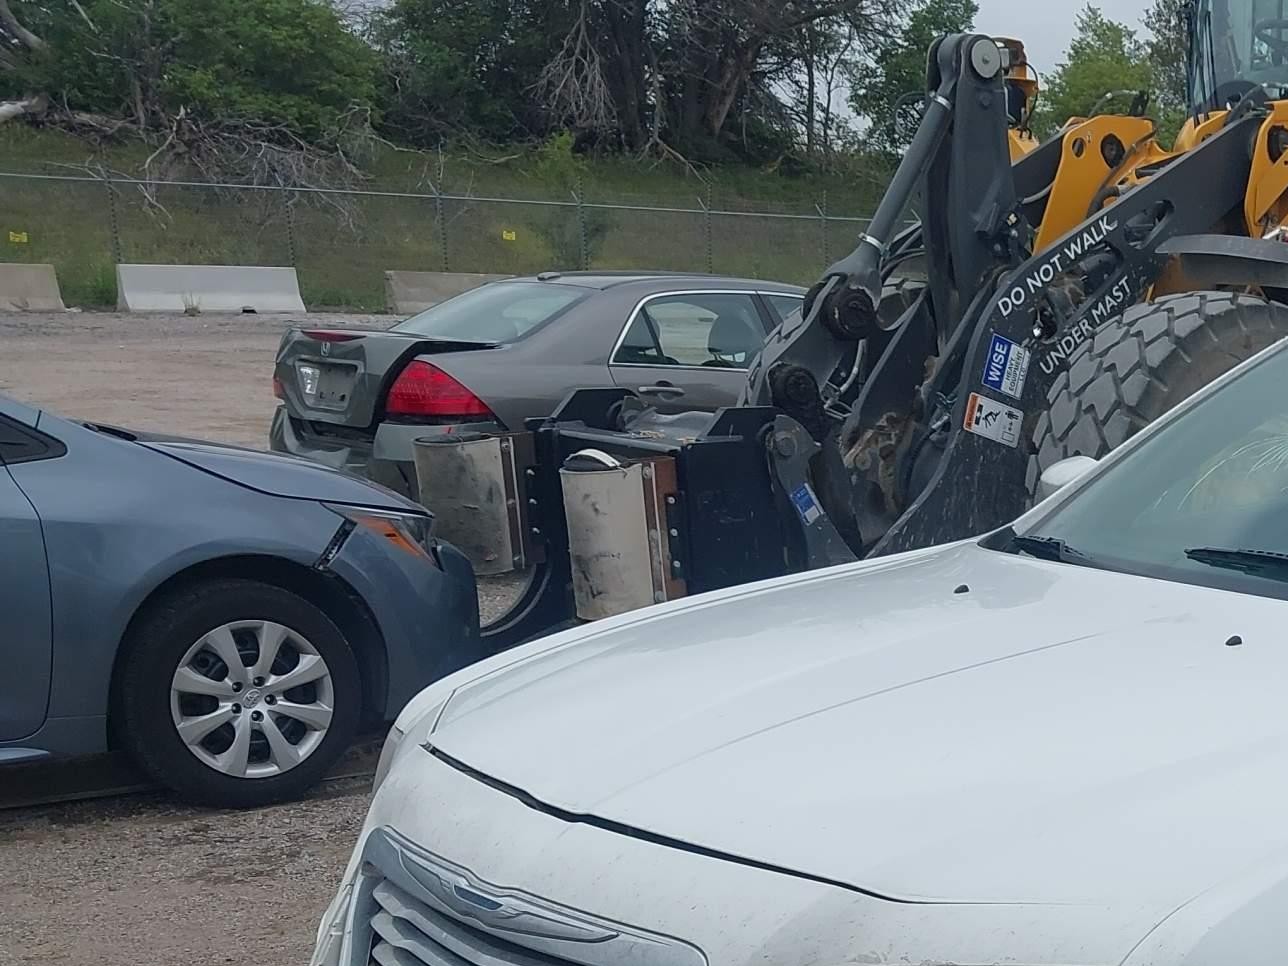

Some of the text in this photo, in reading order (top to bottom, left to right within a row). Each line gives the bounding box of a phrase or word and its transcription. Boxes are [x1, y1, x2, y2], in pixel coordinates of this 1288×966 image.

[998, 215, 1119, 317] DO NOT WALK
[1039, 276, 1131, 374] UNDER MAST
[987, 341, 1008, 382] WISE
[1006, 357, 1015, 381] HEAVY
[1008, 351, 1023, 392] EQUIPMENT
